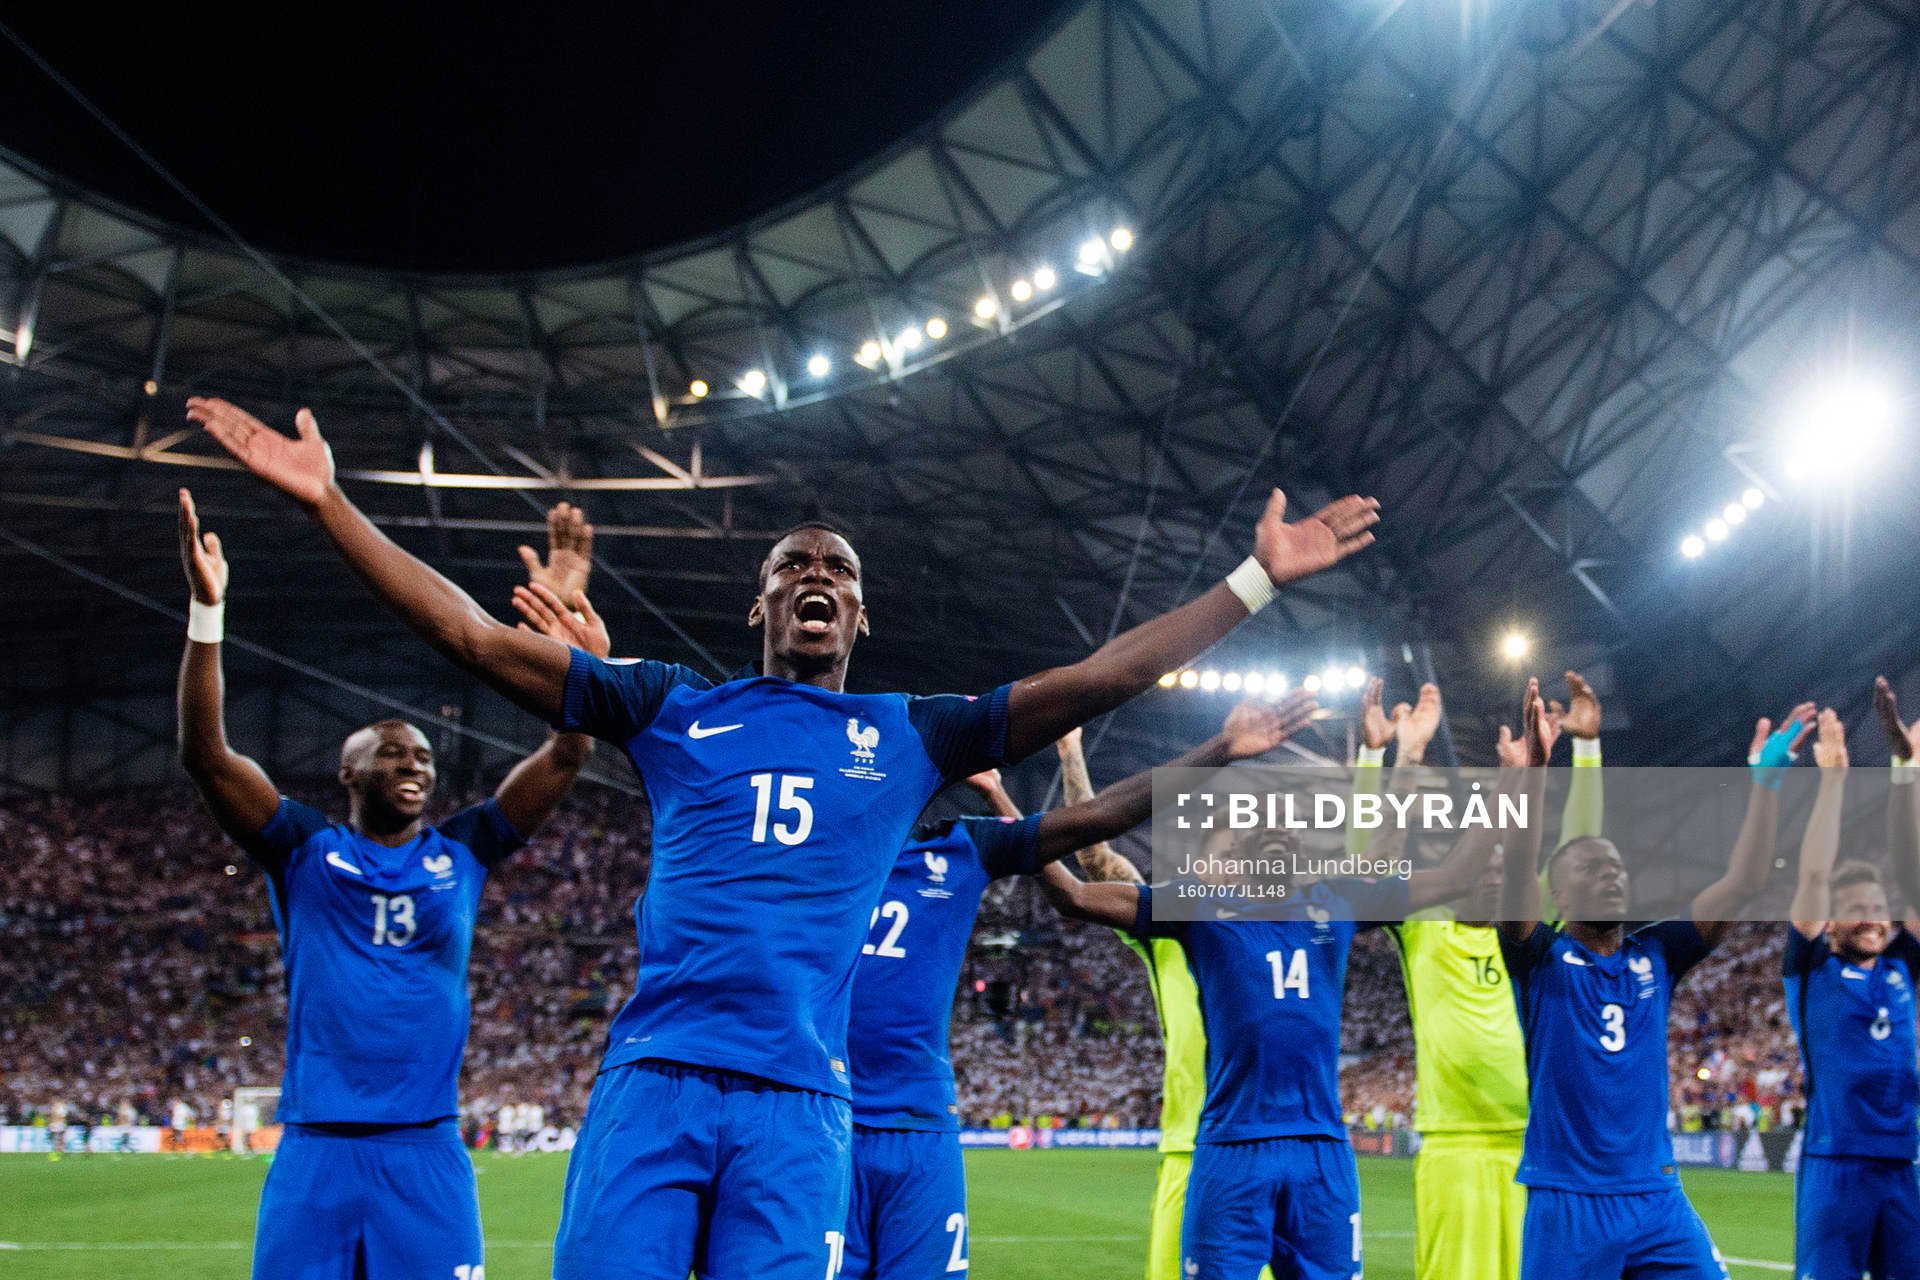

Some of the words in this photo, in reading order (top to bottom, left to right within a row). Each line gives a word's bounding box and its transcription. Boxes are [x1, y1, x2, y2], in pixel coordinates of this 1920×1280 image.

[751, 773, 814, 845] 15
[371, 894, 416, 947] 13
[1266, 948, 1310, 999] 14
[1468, 955, 1502, 985] 16
[1600, 1004, 1626, 1052] 3
